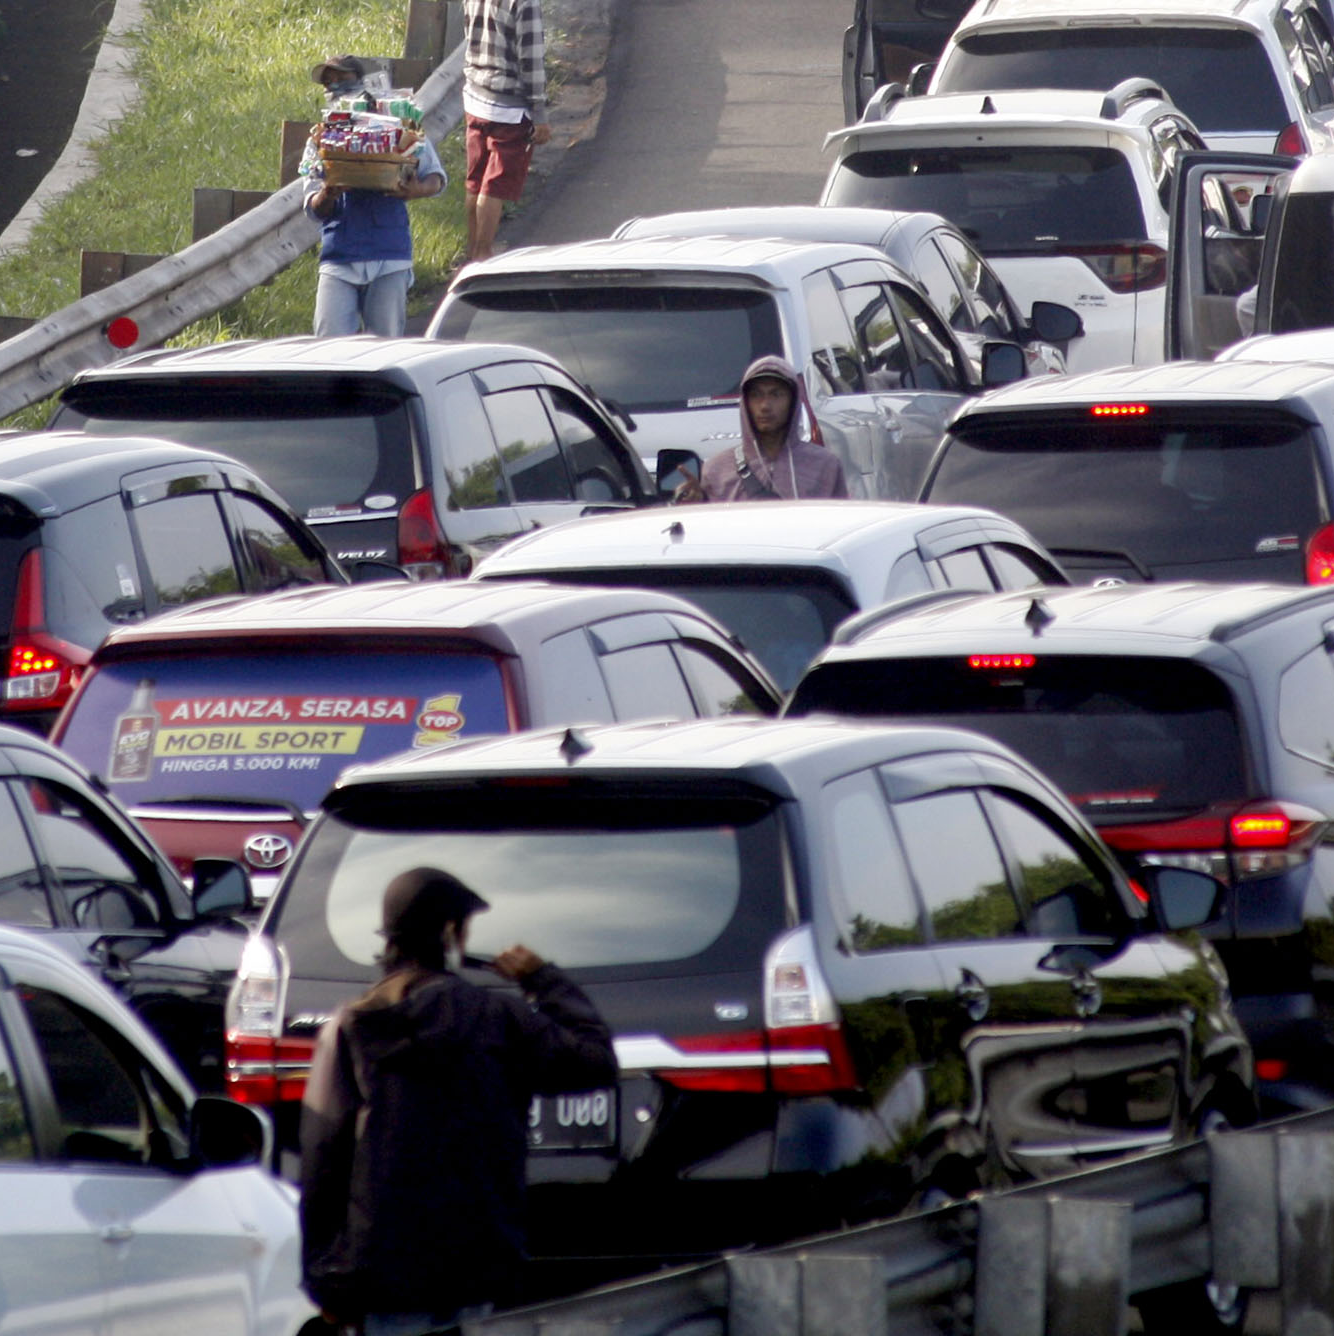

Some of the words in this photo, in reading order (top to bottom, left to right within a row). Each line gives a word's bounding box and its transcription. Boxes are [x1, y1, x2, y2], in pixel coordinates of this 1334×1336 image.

[337, 549, 387, 560] VELOZ
[170, 700, 291, 722] AVANZA,
[298, 699, 407, 720] SERASA
[423, 714, 458, 728] TOP
[163, 733, 247, 752] MOBIL
[253, 730, 347, 750] SPORT
[161, 758, 229, 773] HINGGA
[233, 759, 285, 772] 5.000
[288, 757, 321, 771] KM!
